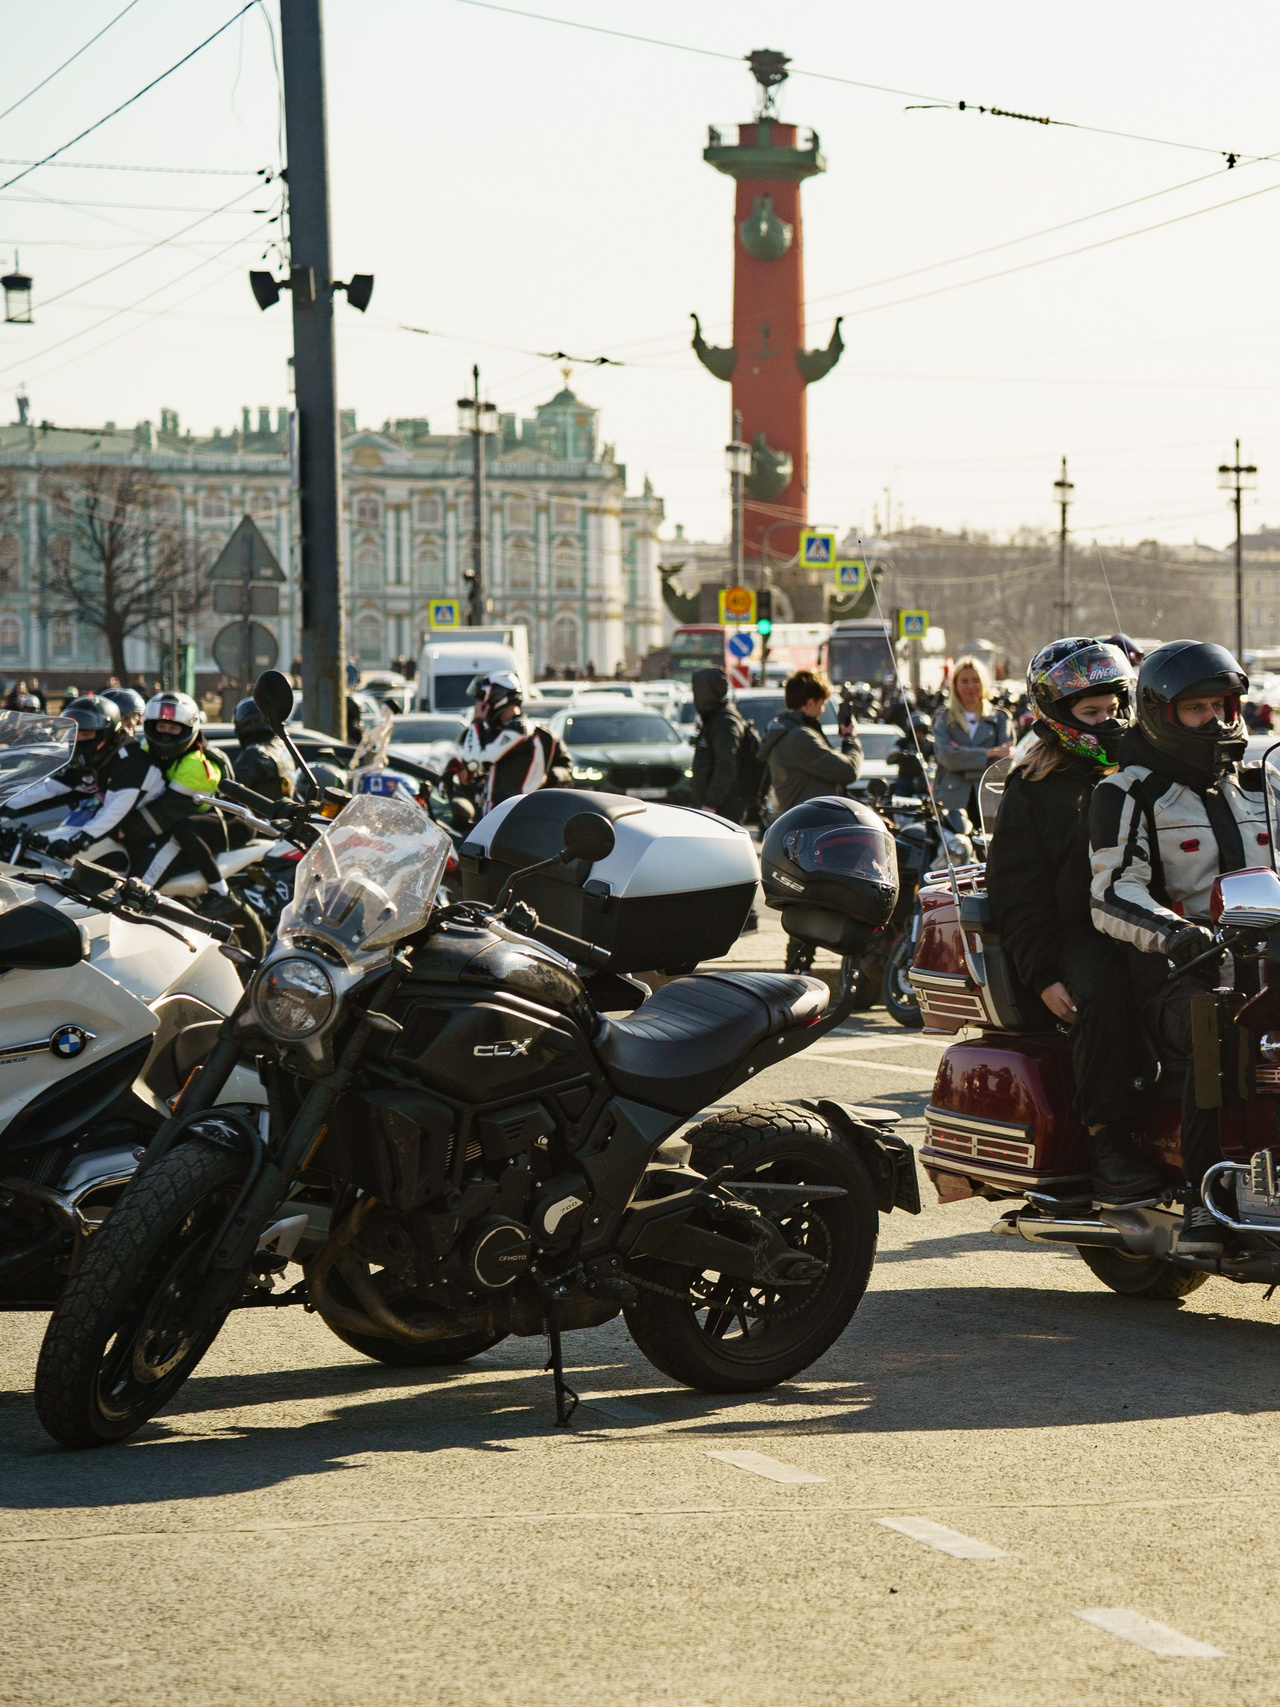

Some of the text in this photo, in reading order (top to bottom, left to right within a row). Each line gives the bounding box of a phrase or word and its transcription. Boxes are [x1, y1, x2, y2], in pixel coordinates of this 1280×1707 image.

[771, 871, 805, 893] LS2
[473, 1038, 531, 1057] CLX
[560, 1201, 578, 1214] 700
[498, 1254, 527, 1262] CFMOTO
